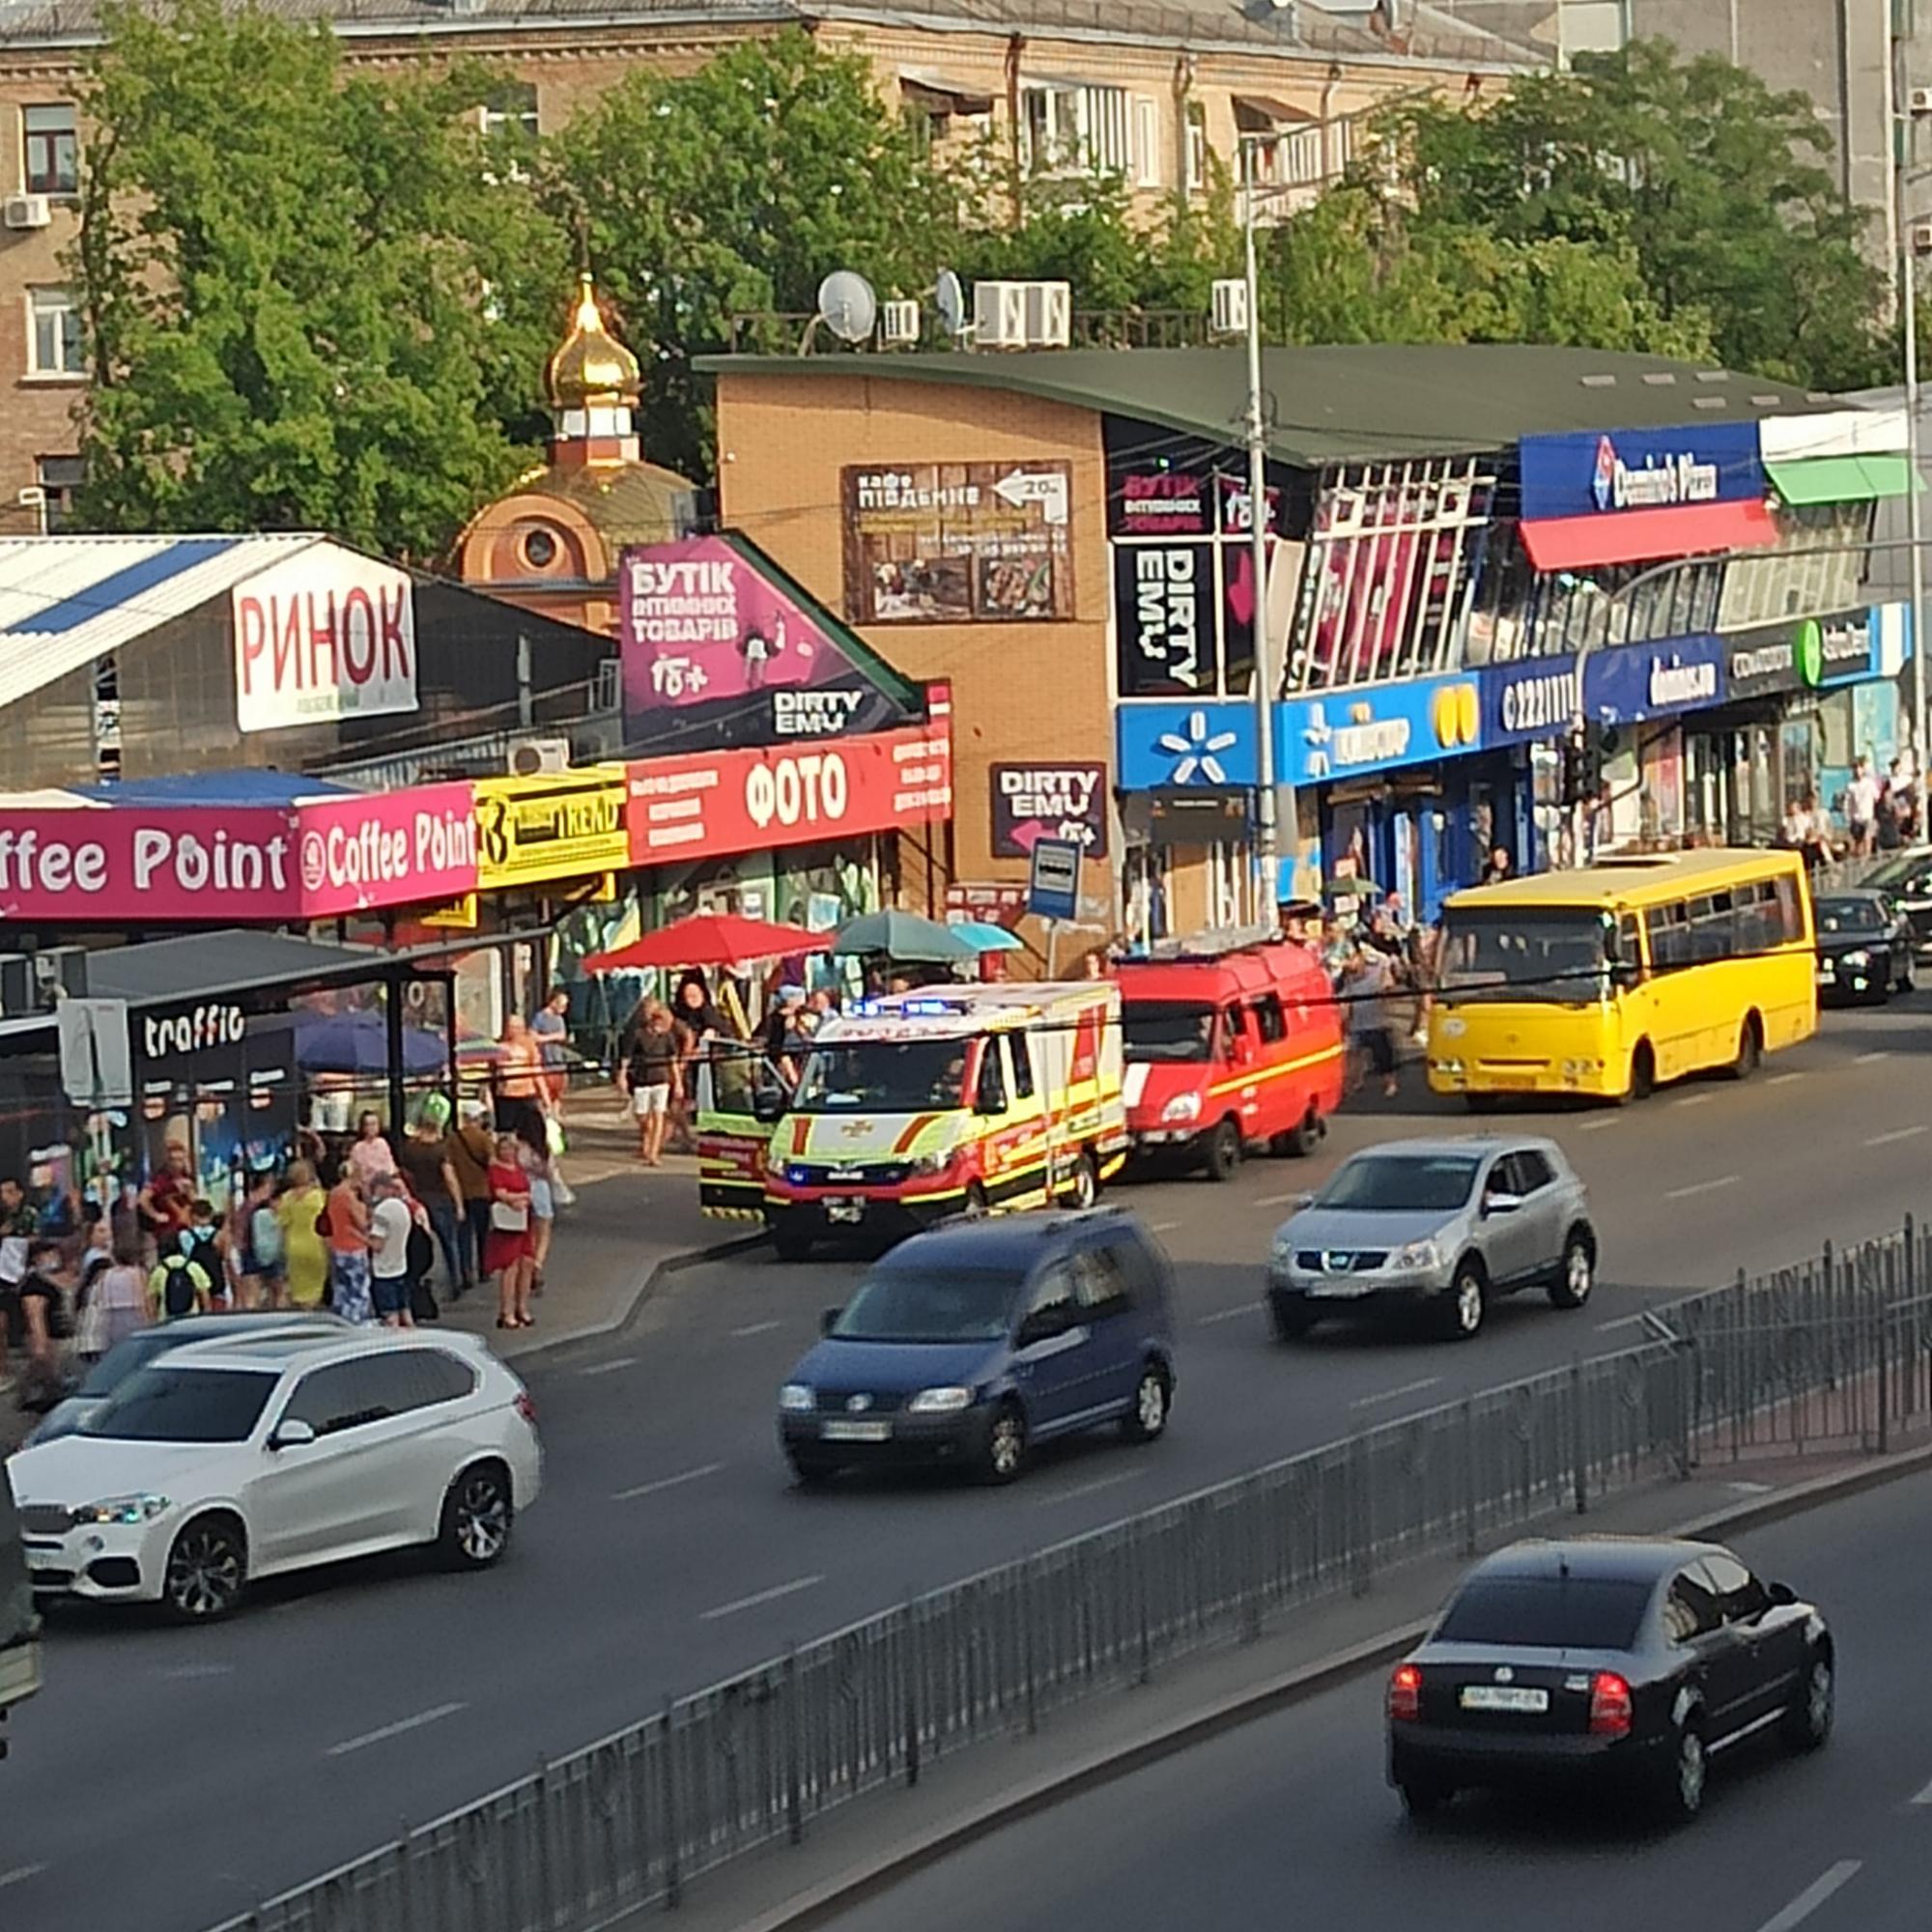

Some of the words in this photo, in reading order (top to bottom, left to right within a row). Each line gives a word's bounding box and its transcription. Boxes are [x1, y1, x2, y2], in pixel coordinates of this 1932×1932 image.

[633, 561, 736, 594] БУТІК
[241, 582, 410, 696] РИНОК
[632, 618, 739, 643] ТОВАРІВ
[1165, 550, 1199, 689] DIRTY
[774, 690, 864, 712] DIRTY
[776, 712, 844, 733] EMU
[746, 753, 847, 829] ФОТО
[1001, 771, 1099, 794] DIRTY
[1011, 794, 1090, 817] EMU
[133, 829, 288, 891] Point
[327, 819, 409, 888] Coffee
[415, 810, 477, 873] Point
[145, 1004, 245, 1058] traffic
